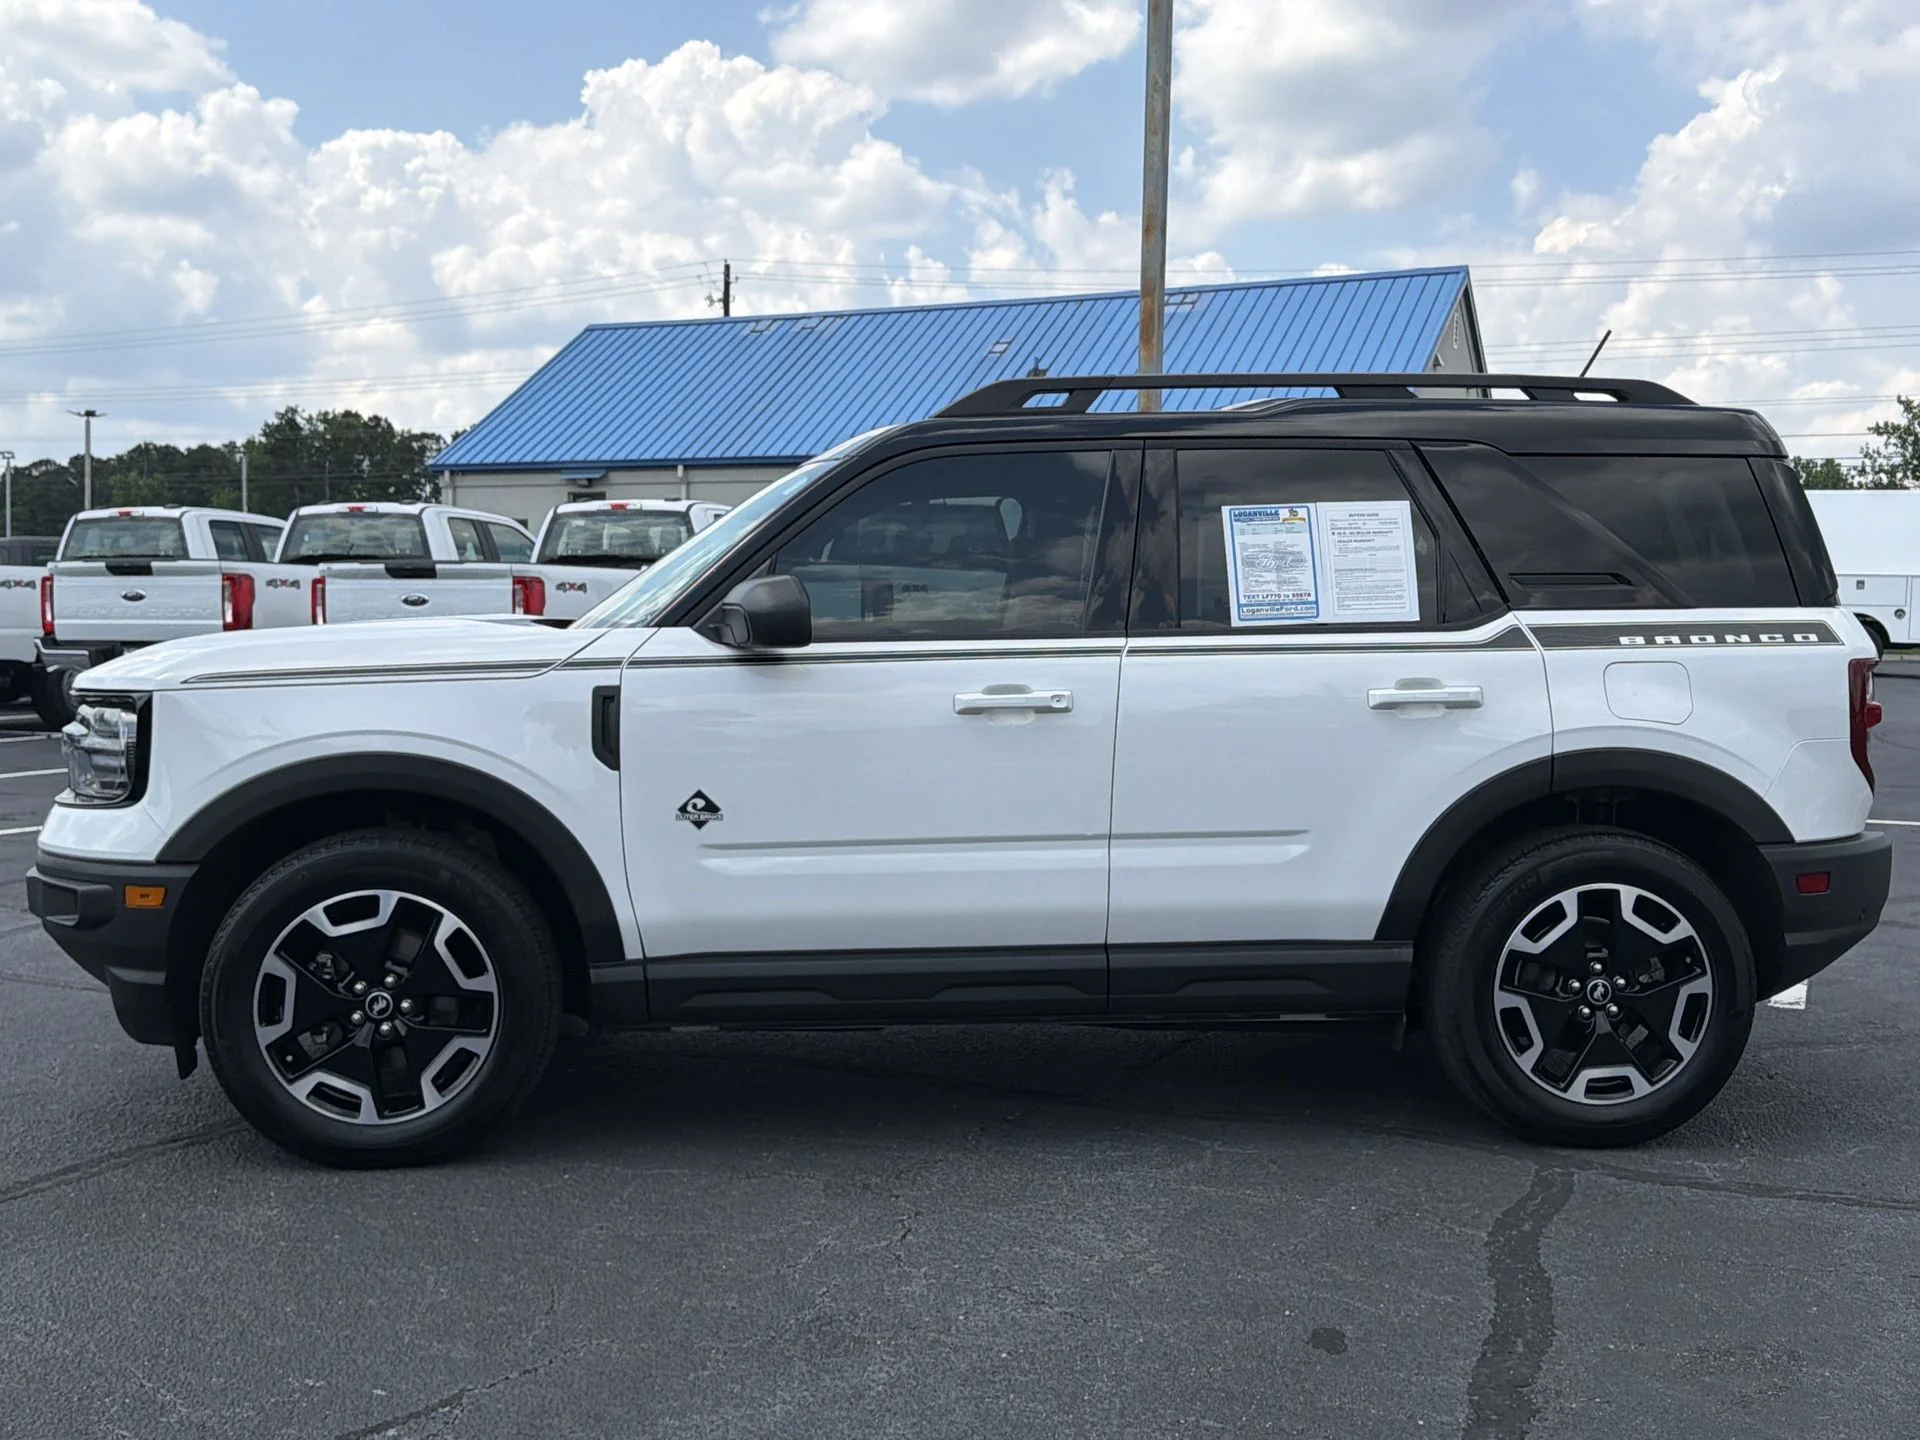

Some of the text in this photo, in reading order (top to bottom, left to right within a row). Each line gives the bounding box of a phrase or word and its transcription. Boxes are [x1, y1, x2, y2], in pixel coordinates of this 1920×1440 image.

[1233, 509, 1280, 517] LOGANVILLE
[1241, 606, 1316, 615] LoganvilleFord.com
[1618, 633, 1819, 645] BRONCO
